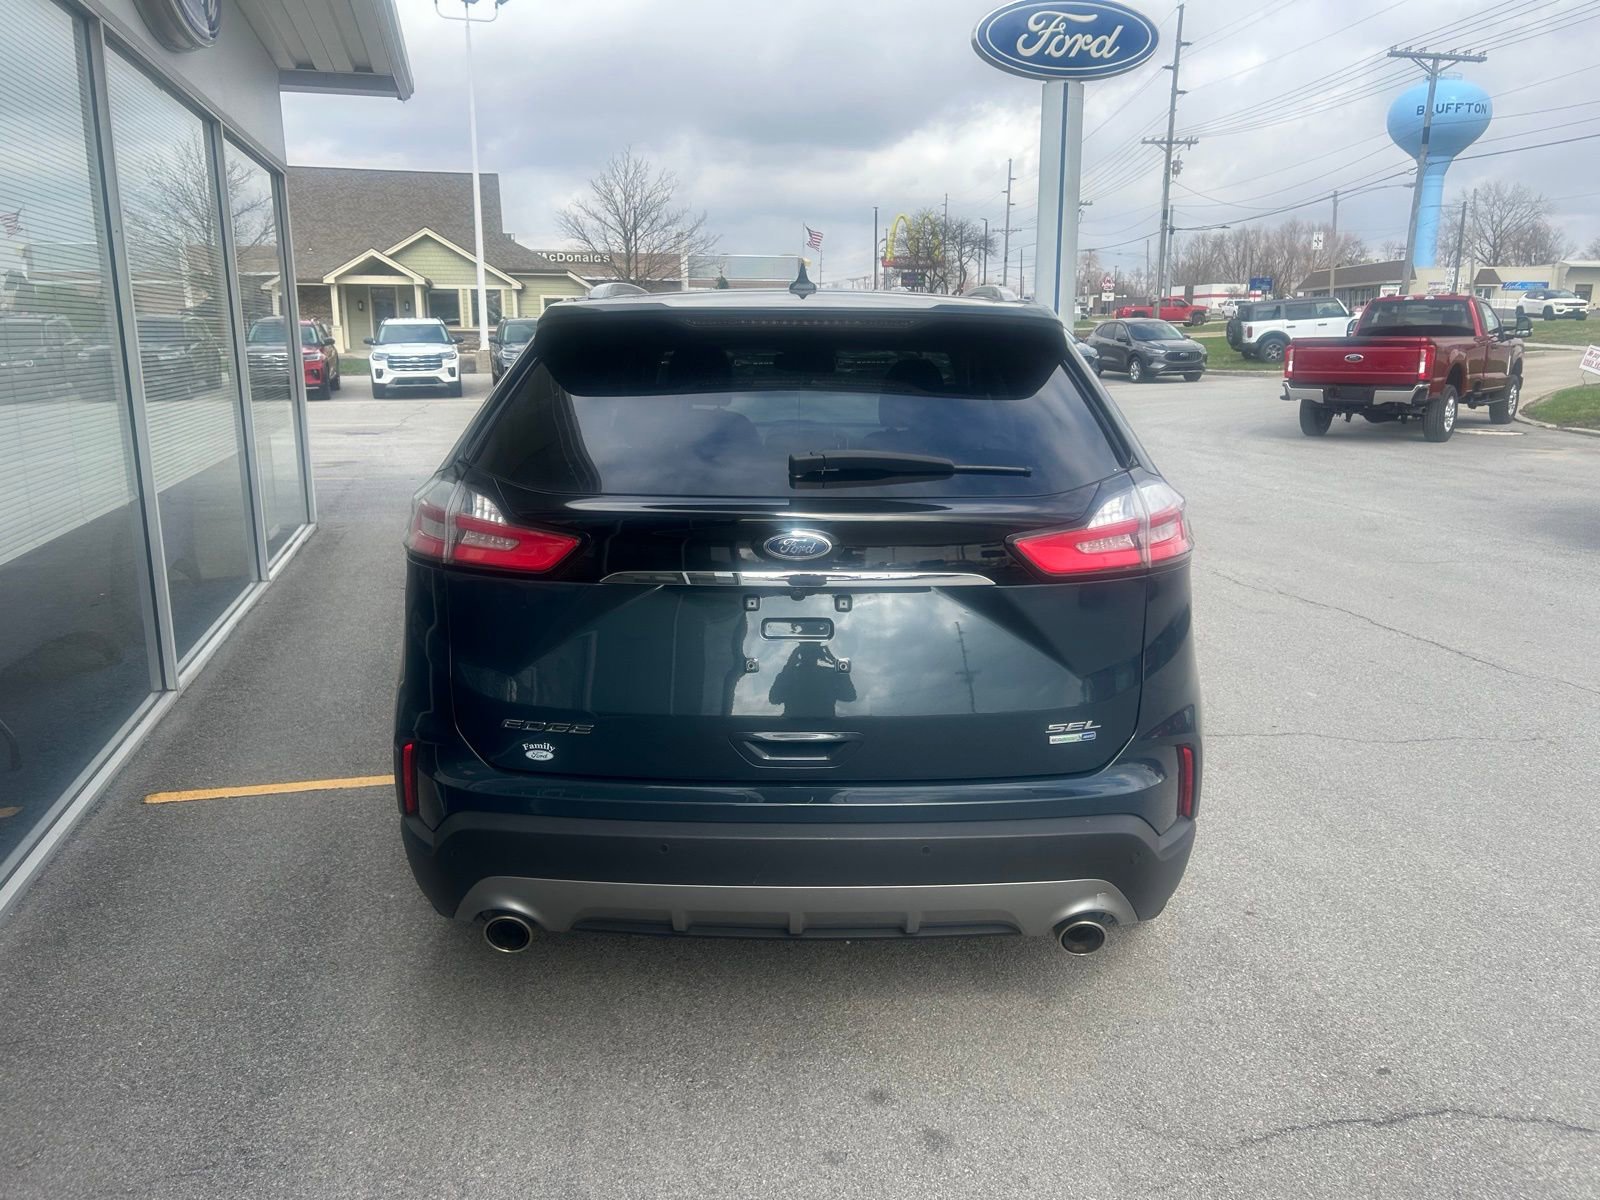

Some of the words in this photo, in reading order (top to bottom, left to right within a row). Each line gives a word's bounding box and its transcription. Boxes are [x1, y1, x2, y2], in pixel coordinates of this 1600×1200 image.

[1016, 10, 1124, 59] Ford
[1416, 103, 1487, 116] BUFFTON
[780, 538, 817, 554] Ford
[501, 719, 594, 734] EDGE
[1045, 720, 1102, 733] SEL
[522, 742, 556, 753] Family
